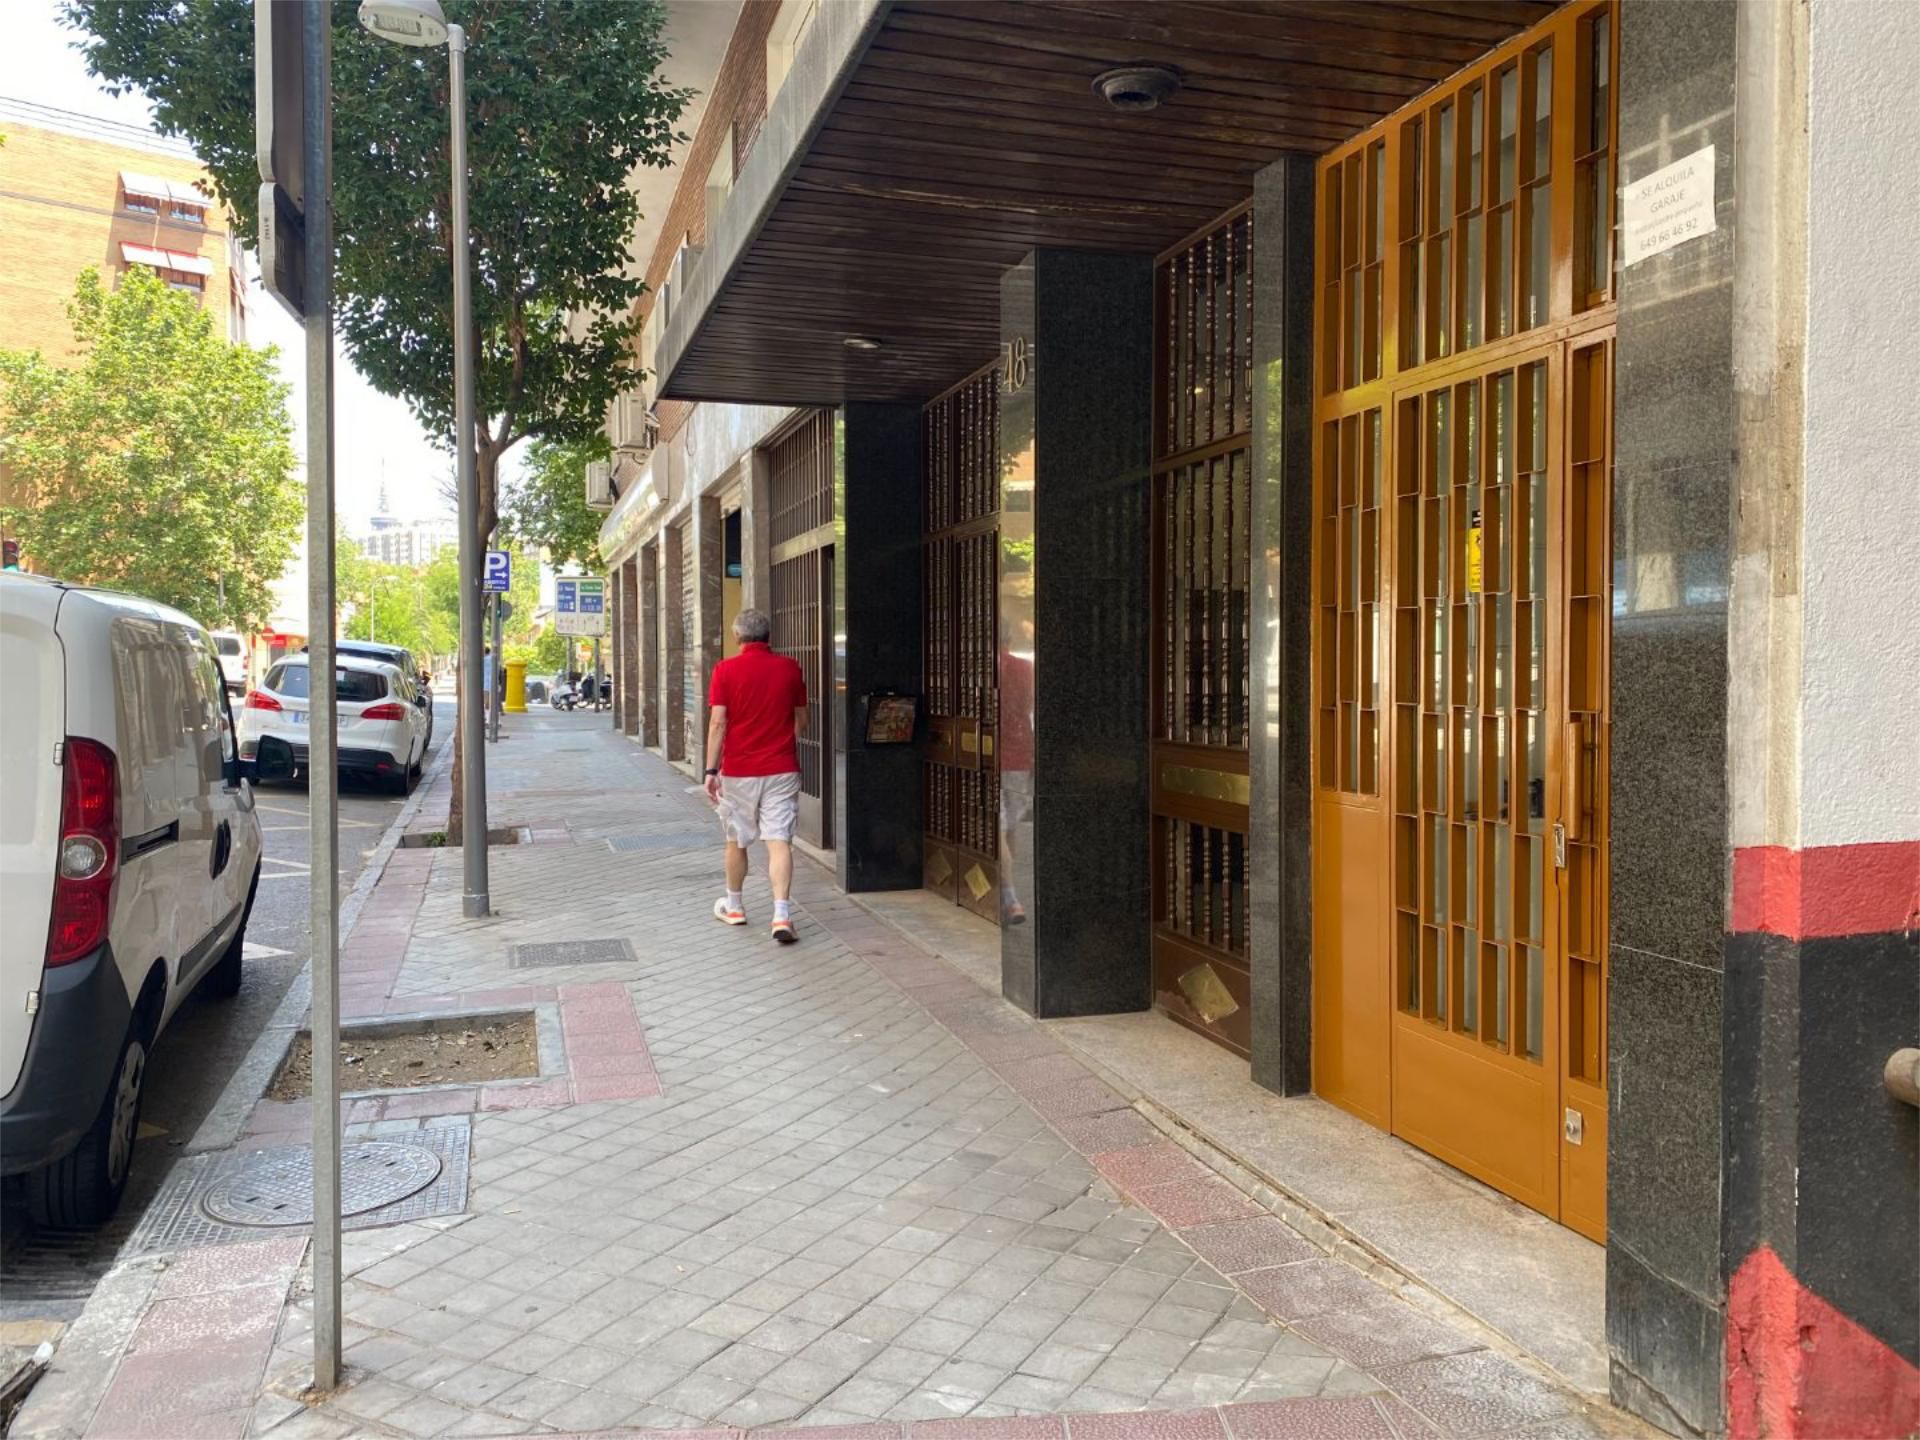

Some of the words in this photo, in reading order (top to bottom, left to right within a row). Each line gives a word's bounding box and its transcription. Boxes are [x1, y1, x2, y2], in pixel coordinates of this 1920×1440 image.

[1641, 186, 1653, 200] SE
[1654, 167, 1695, 194] ALQUILA
[1650, 188, 1685, 213] GARAJE
[1686, 217, 1697, 232] 92
[484, 553, 507, 579] P
